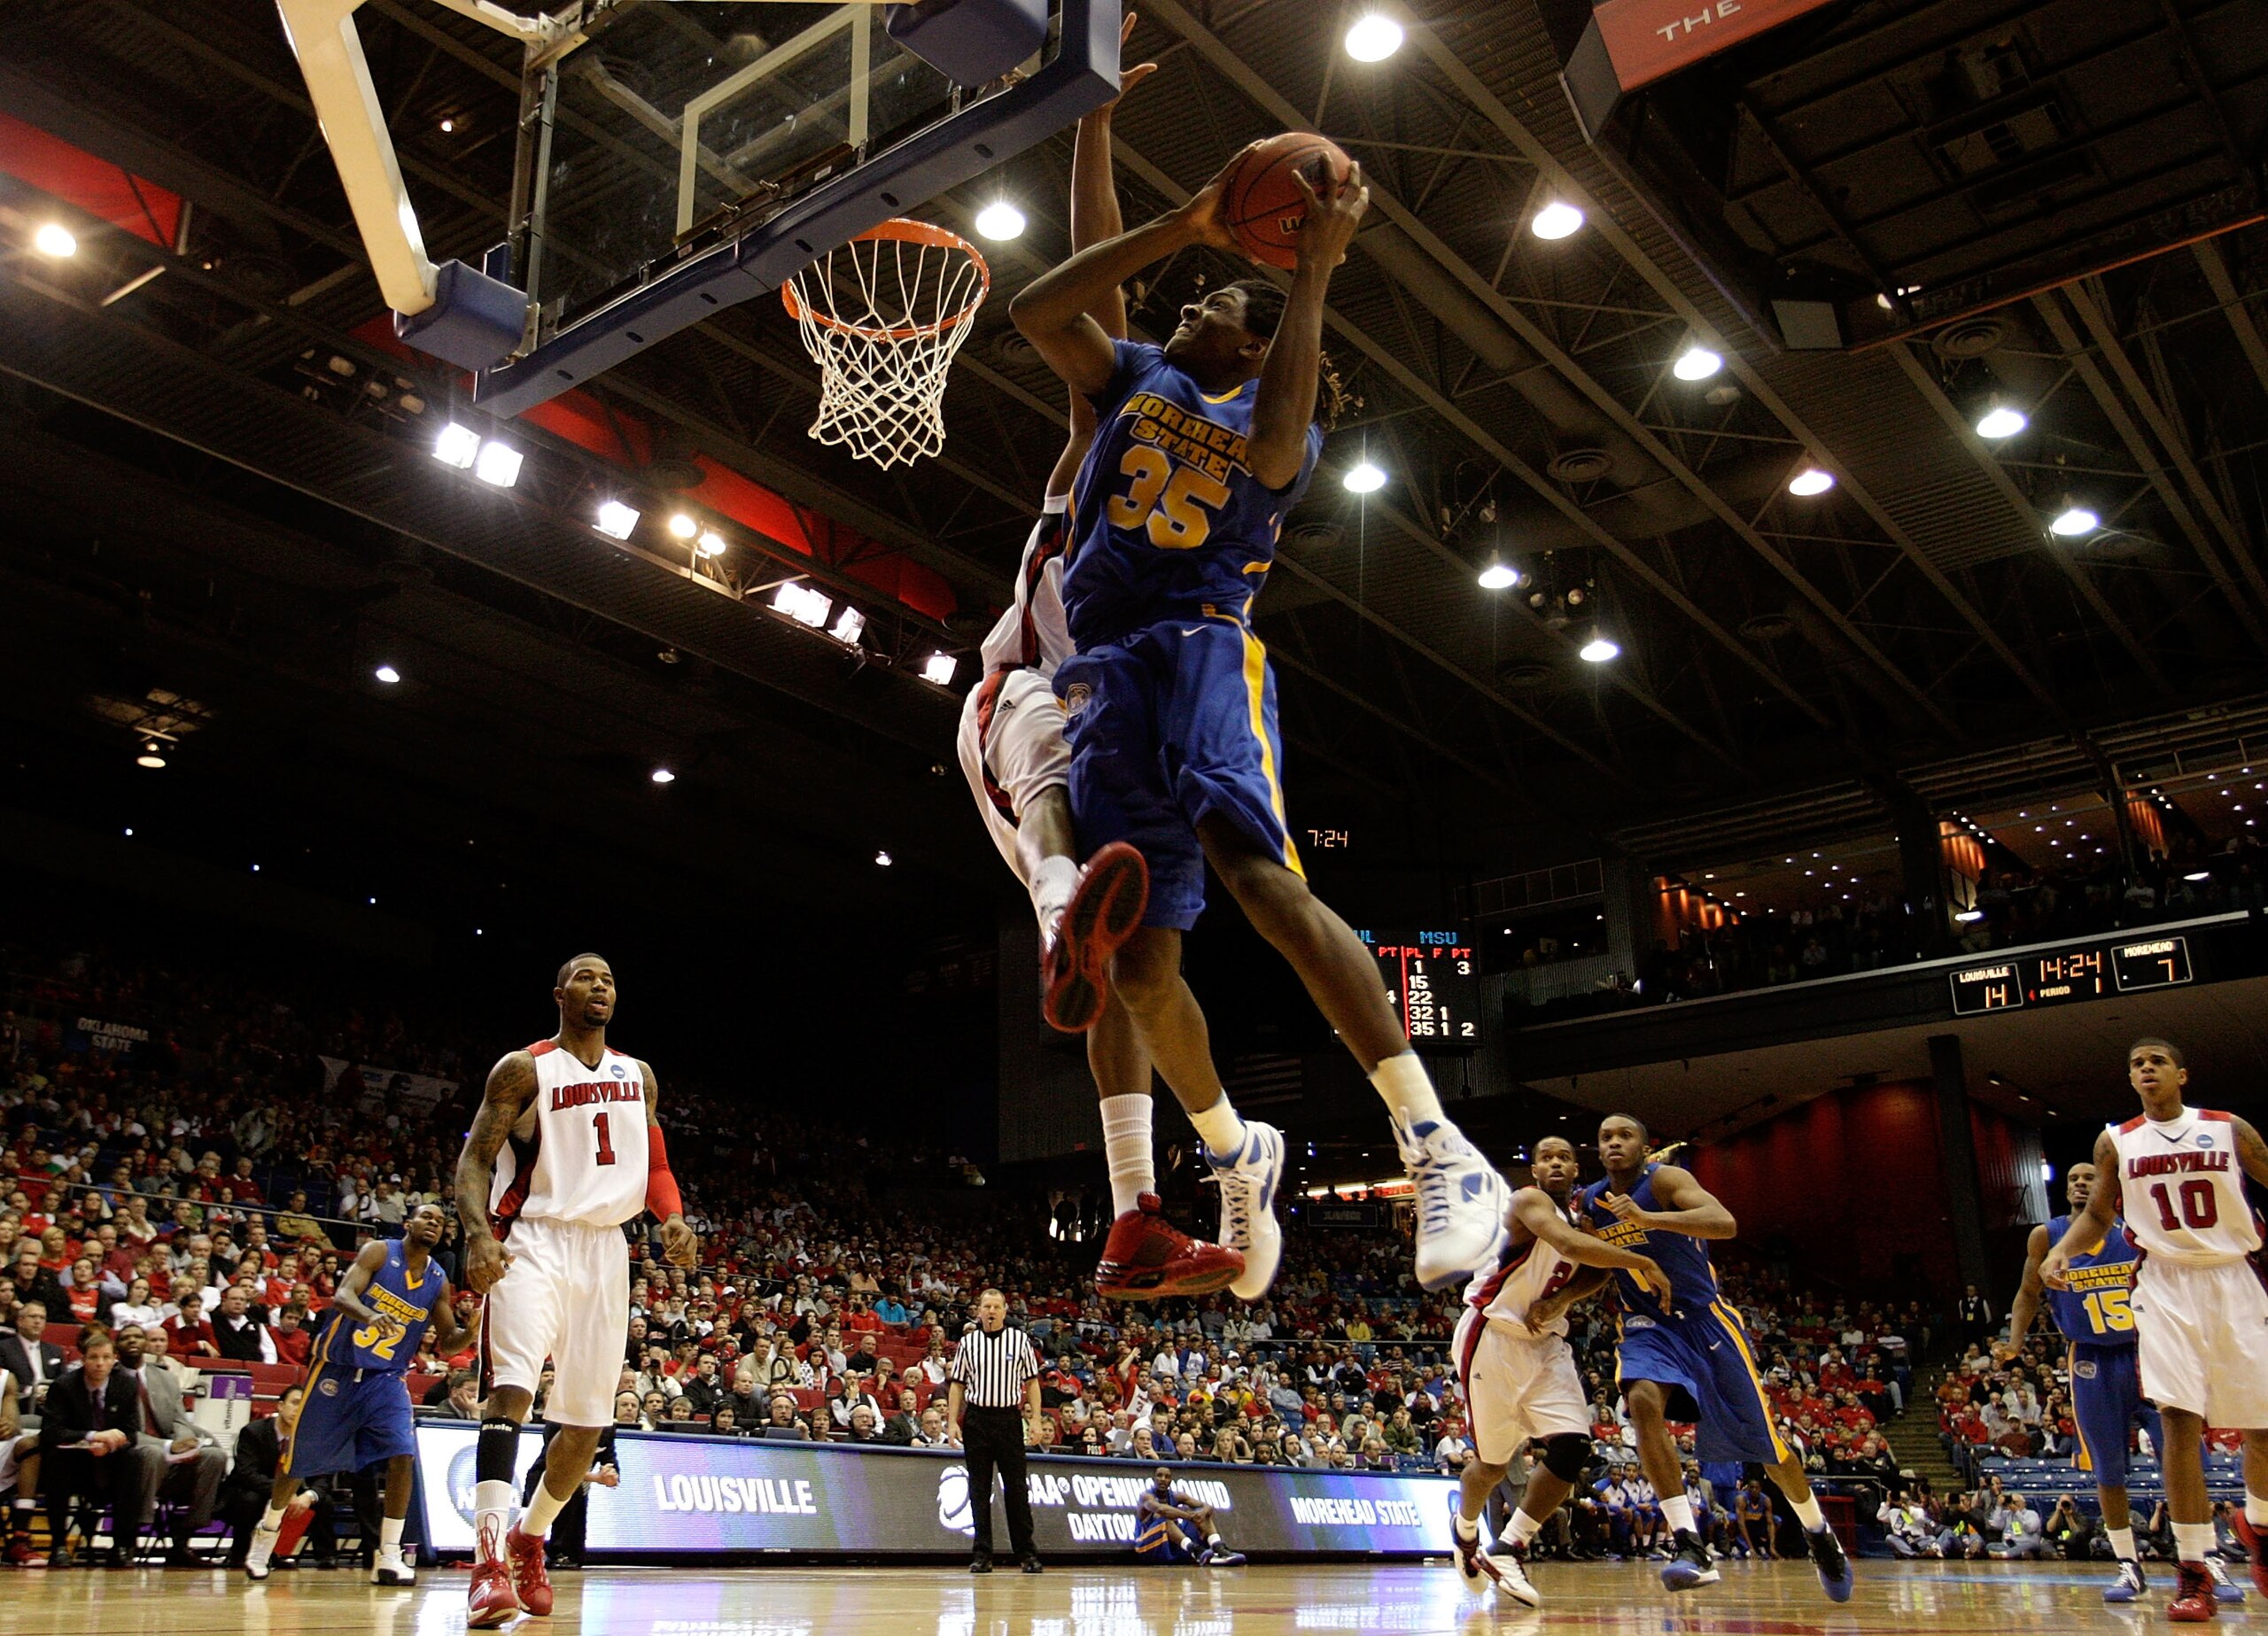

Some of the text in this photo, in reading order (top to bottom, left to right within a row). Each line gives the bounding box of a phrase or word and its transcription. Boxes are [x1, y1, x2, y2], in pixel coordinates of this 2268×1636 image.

[1656, 0, 1741, 42] THE
[1131, 416, 1232, 484] STATE
[1107, 443, 1233, 549] 35
[1307, 829, 1348, 848] 7:24
[1419, 931, 1457, 944] MSU
[2124, 941, 2175, 958] MOREHEAD
[1379, 946, 1397, 958] PT
[1406, 947, 1472, 958] PL F PT
[1414, 960, 1471, 975] 1 3
[1959, 966, 2010, 983] LOUISVILLE
[2039, 950, 2101, 982] 14:24
[2157, 958, 2174, 981] 7
[1409, 975, 1429, 989] 15
[2039, 985, 2070, 997] PERIOD
[1408, 990, 1433, 1004] 22
[1985, 983, 2006, 1008] 14
[1409, 1005, 1449, 1020] 32 1
[77, 1017, 149, 1042] OKLAHOMA
[1410, 1021, 1475, 1036] 35 1 2
[91, 1034, 132, 1052] STATE
[549, 1081, 641, 1112] LOUISVILLE
[593, 1112, 616, 1166] 1
[2127, 1151, 2229, 1180] LOUISVILLE
[2149, 1179, 2218, 1231] 10
[2065, 1263, 2134, 1282] OREHEA
[2073, 1275, 2129, 1291] STATE
[368, 1283, 429, 1322] MOREHEAD
[2082, 1289, 2135, 1334] 15
[353, 1324, 408, 1361] 32
[652, 1474, 817, 1514] LOUISVILLE
[1169, 1478, 1232, 1510] OUND
[1290, 1497, 1422, 1528] MOREHEAD STATE
